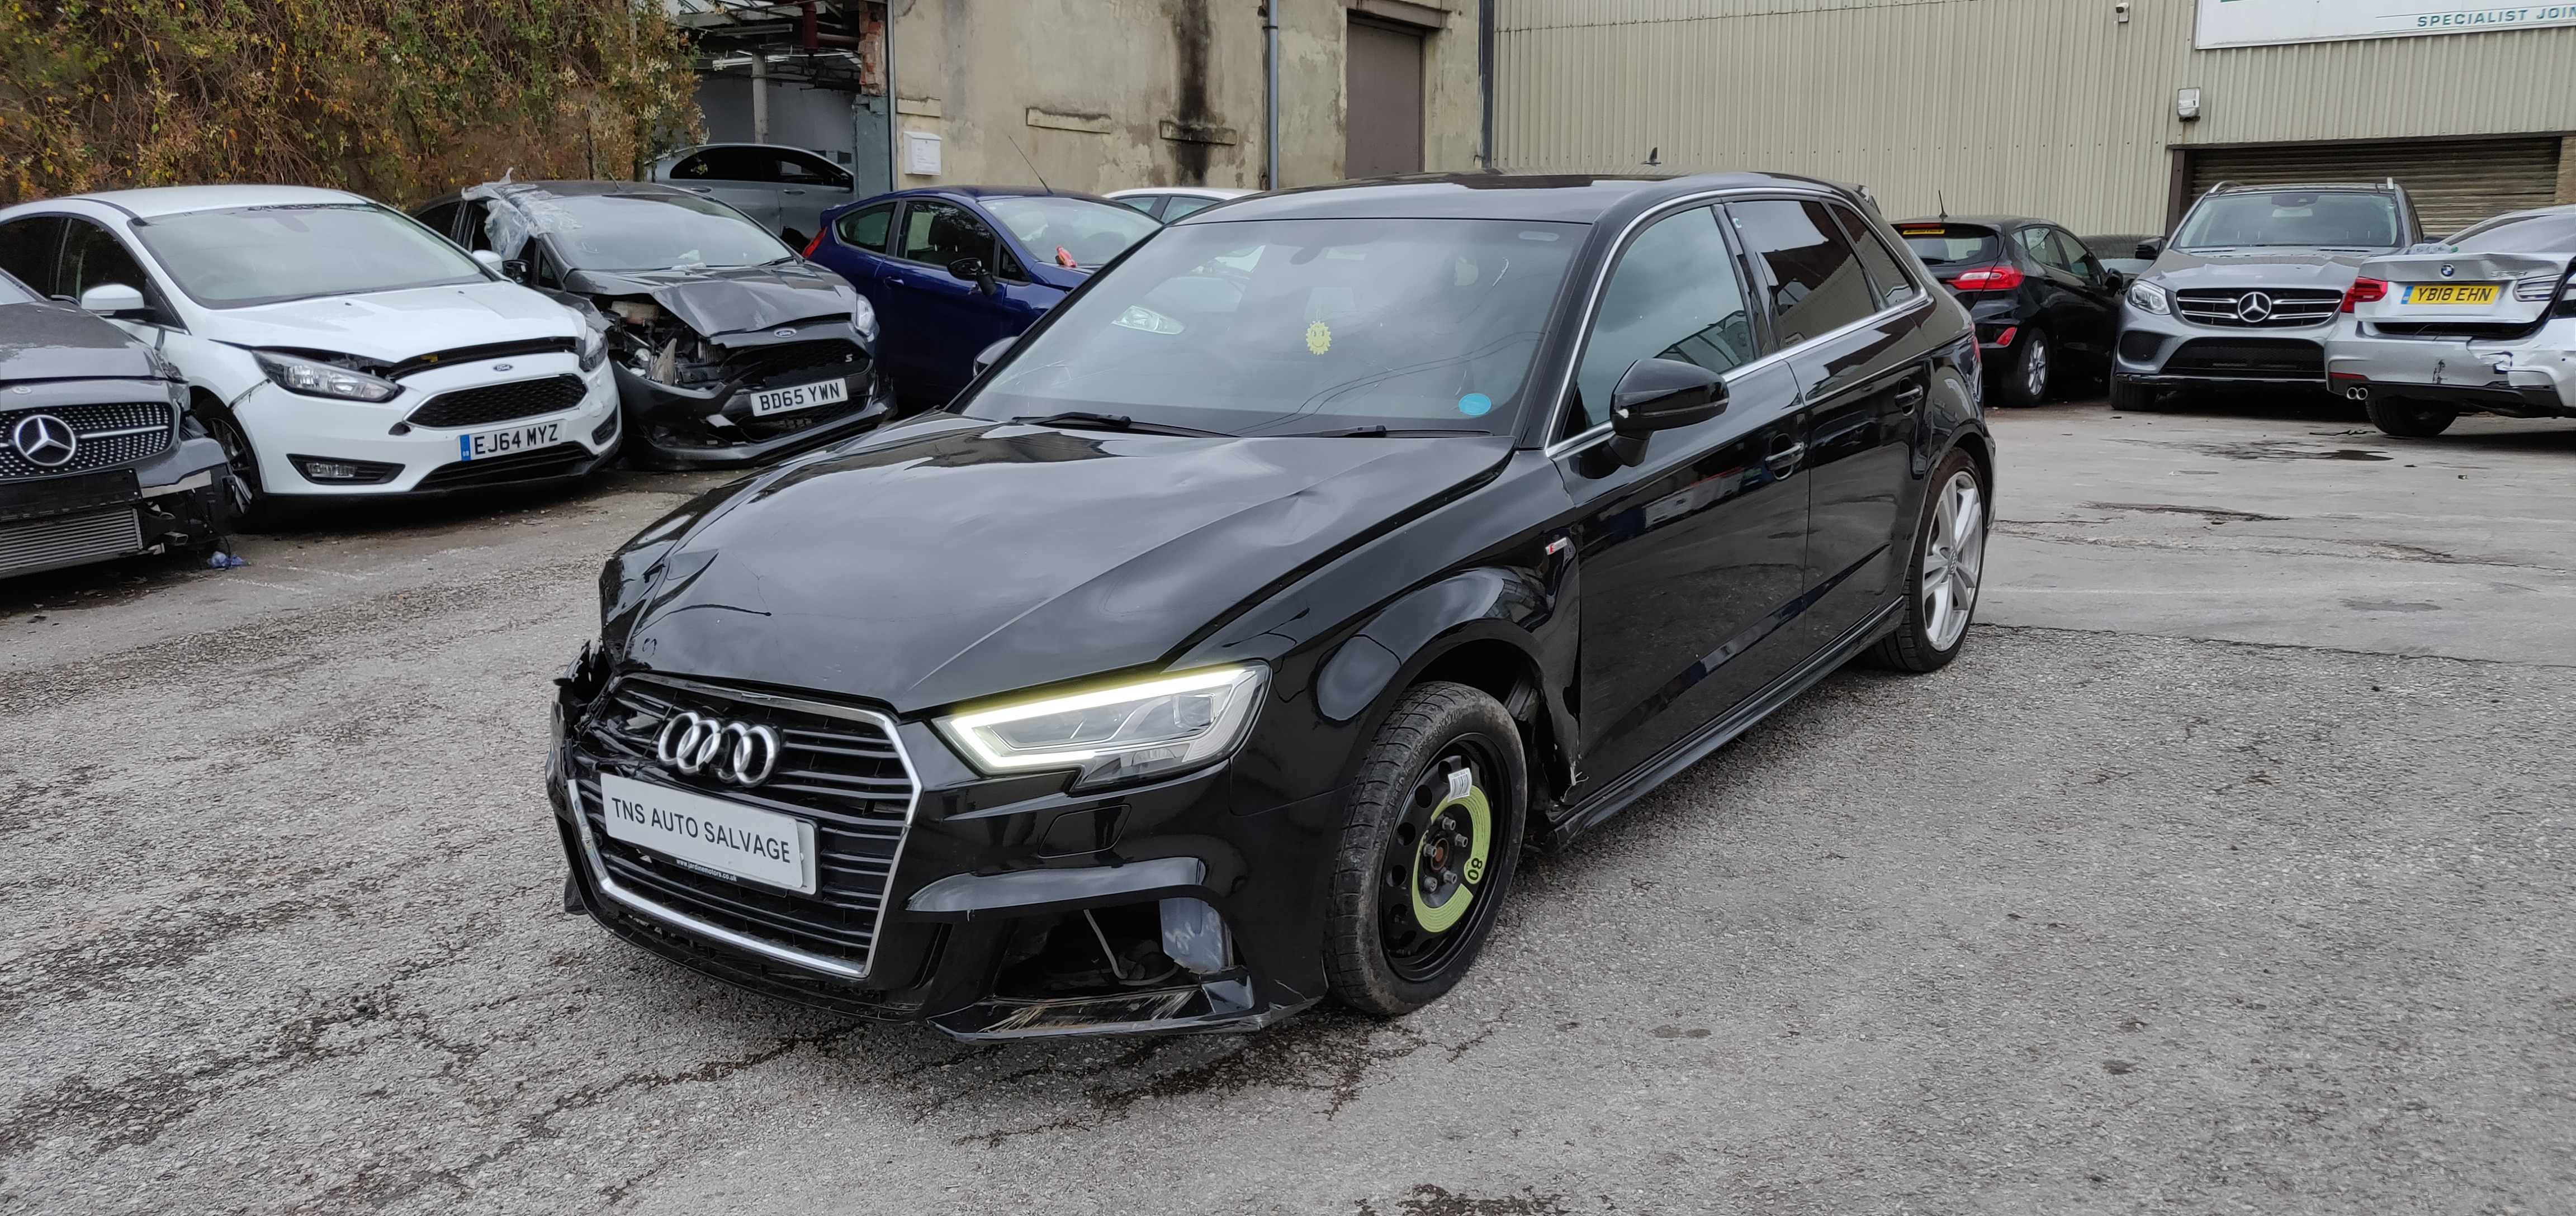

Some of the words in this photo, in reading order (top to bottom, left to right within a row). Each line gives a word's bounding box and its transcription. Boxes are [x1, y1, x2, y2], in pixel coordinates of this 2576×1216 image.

[2417, 10, 2528, 27] SPECIALIST
[2418, 288, 2454, 302] YB18
[2456, 288, 2492, 301] EHN
[759, 389, 804, 411] BD65
[808, 382, 840, 402] YWN
[474, 430, 521, 455] EJ64
[527, 424, 558, 446] MYZ
[611, 797, 646, 824] TNS
[651, 808, 699, 838] AUTO
[703, 821, 792, 864] SALVAGE
[675, 858, 738, 882] www.jardinemotors.co.uk
[1467, 857, 1483, 881] 80
